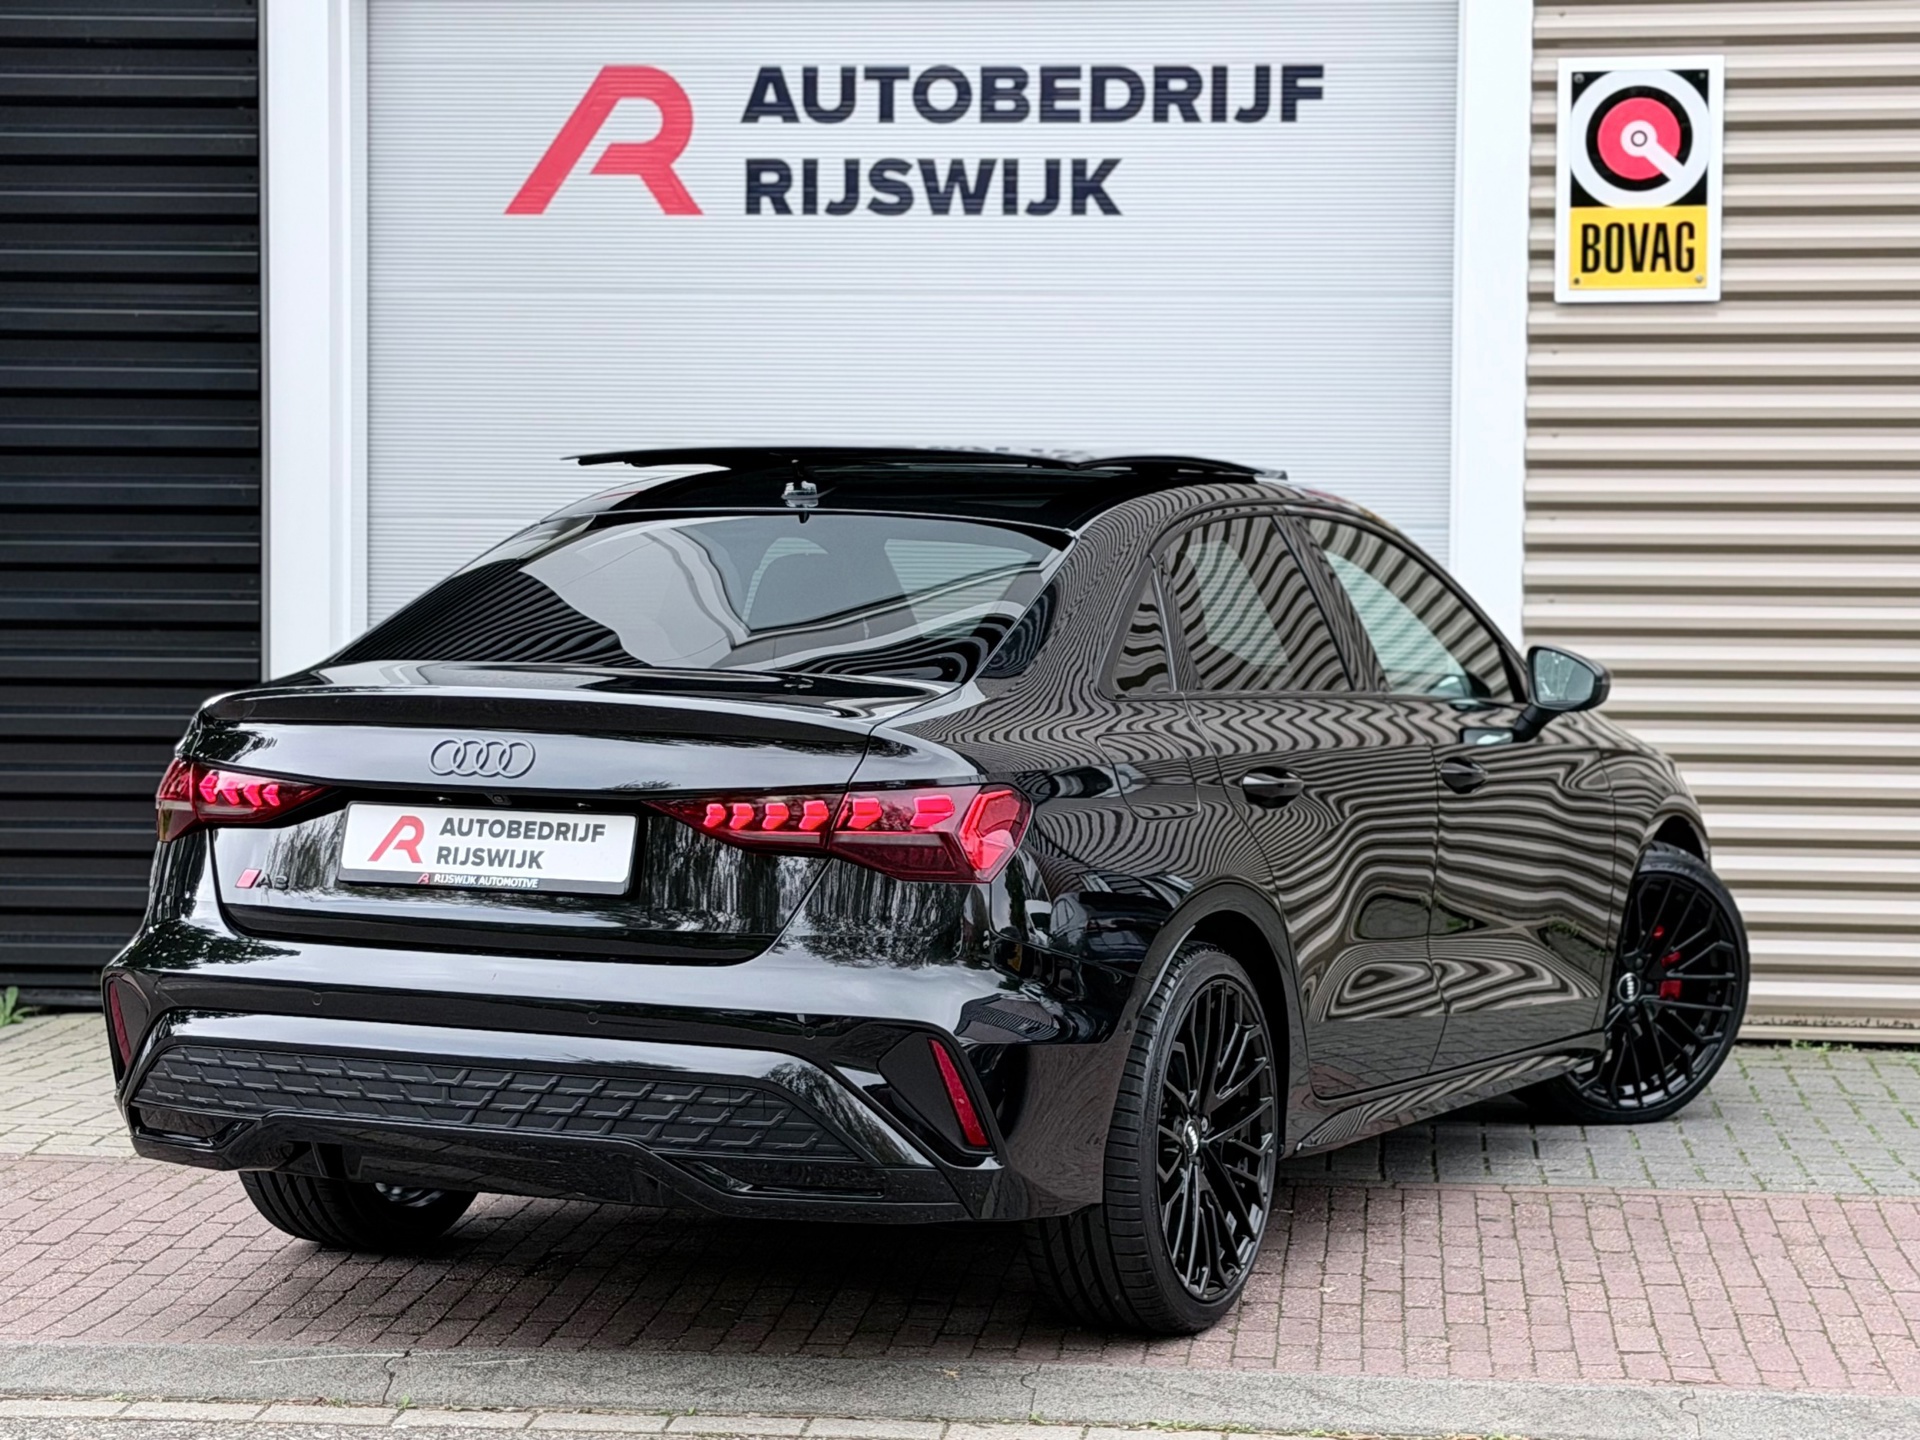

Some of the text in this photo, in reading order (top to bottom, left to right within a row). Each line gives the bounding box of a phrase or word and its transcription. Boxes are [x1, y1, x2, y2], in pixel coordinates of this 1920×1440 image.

[742, 65, 1323, 123] AUTOBEDRIJF
[746, 158, 1121, 216] RIJSWIJK
[1581, 222, 1694, 273] BOVAG
[439, 817, 606, 842] AUTOBEDRIJF
[436, 846, 545, 869] RIJSWIJK
[434, 874, 539, 888] RIJSWIJK AUTOMOTIVE
